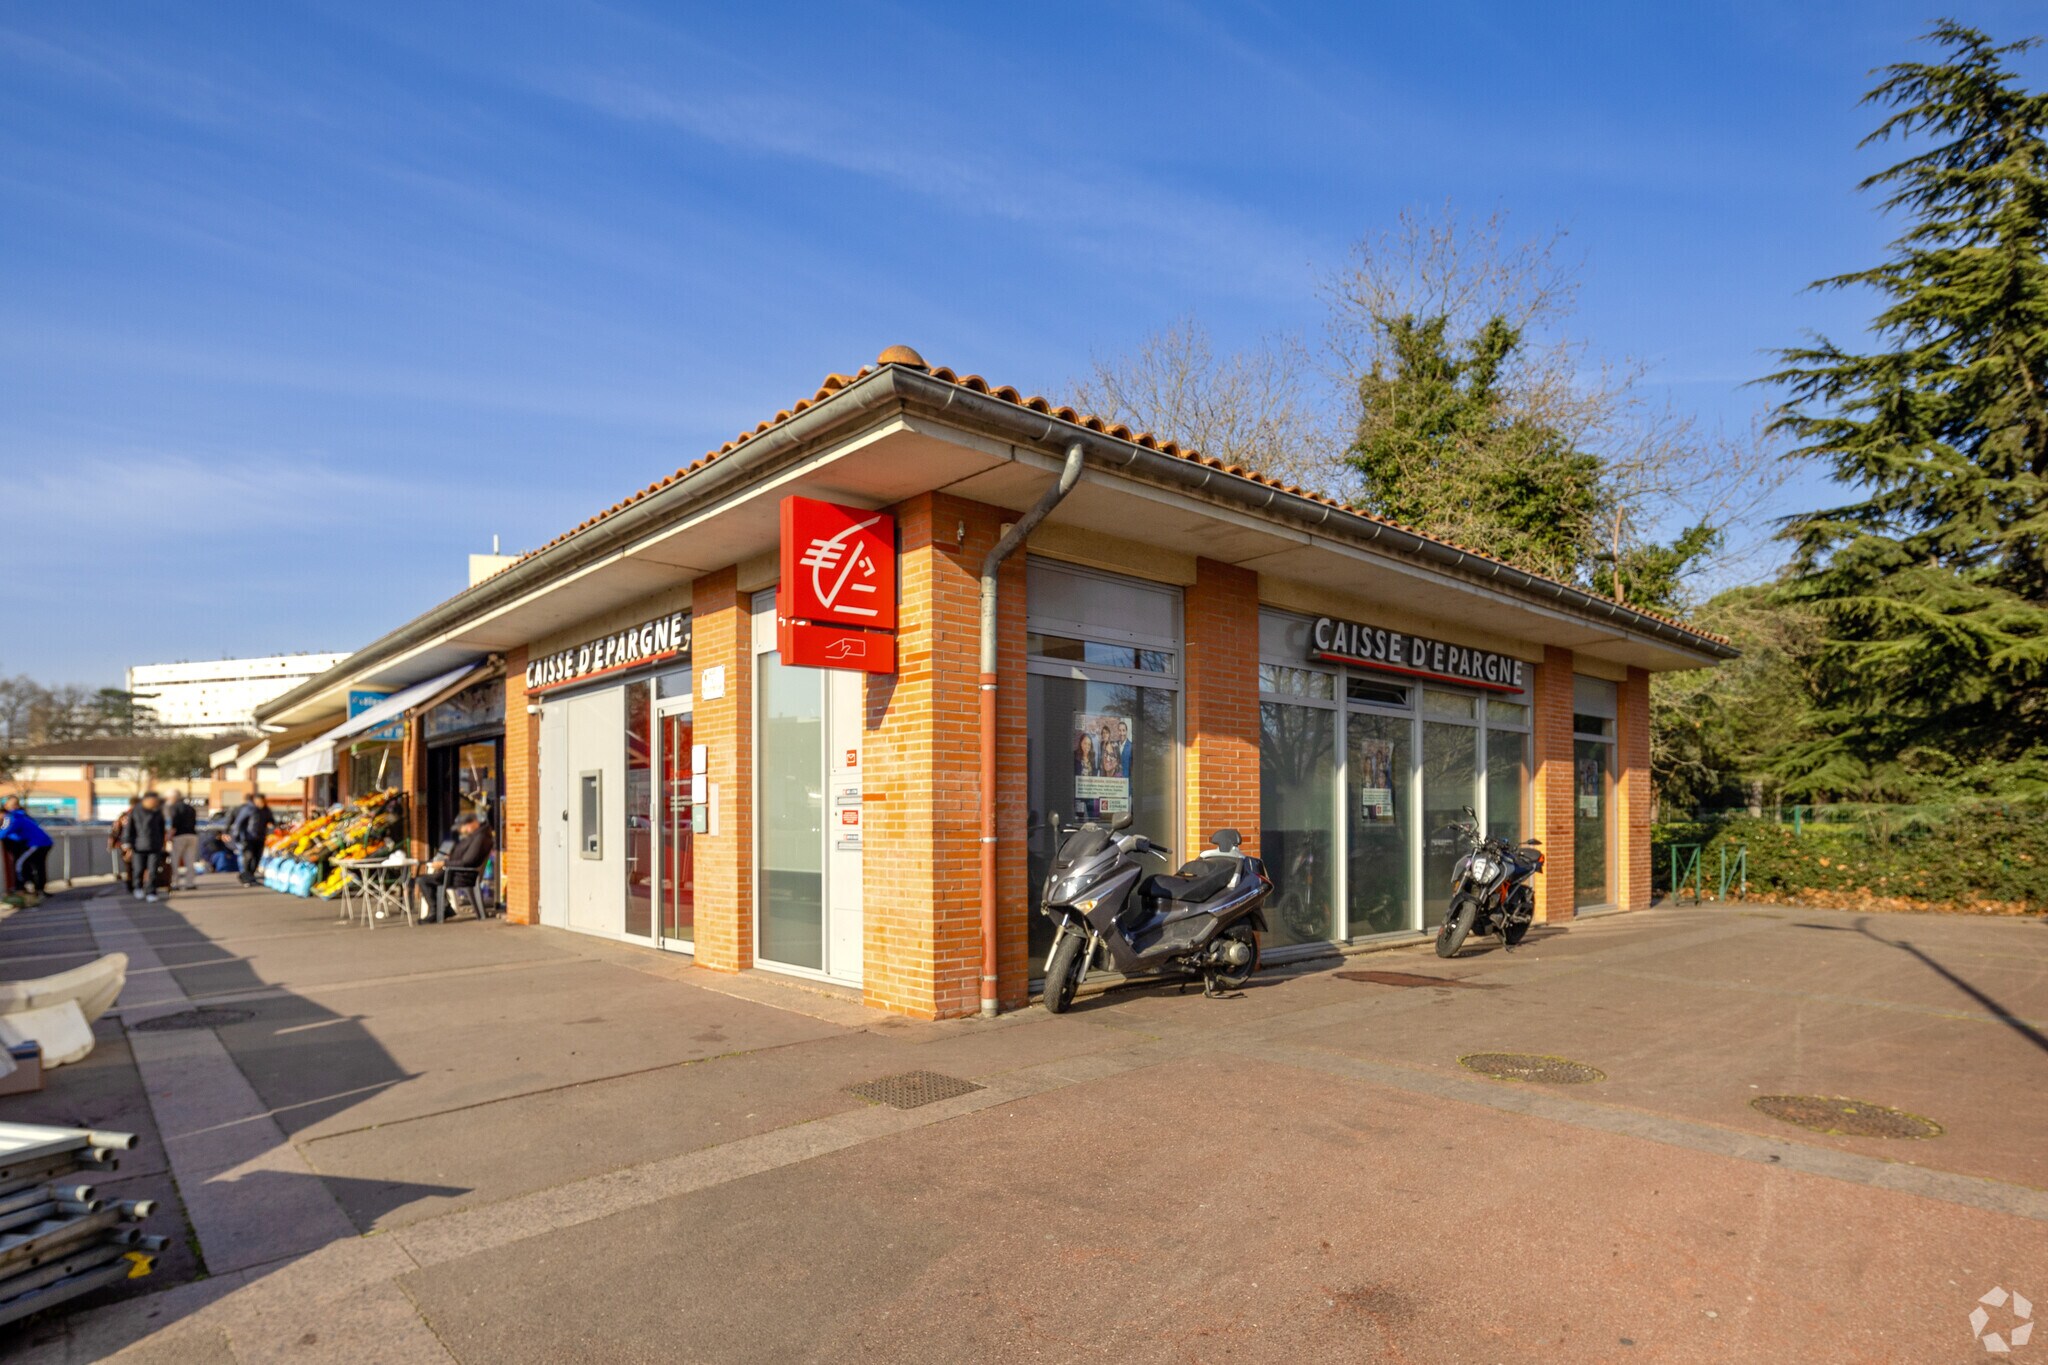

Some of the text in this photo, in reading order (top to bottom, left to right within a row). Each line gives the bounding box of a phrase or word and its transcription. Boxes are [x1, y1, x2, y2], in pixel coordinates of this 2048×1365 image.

[525, 614, 682, 689] CAISSE D'EPARGNE
[1314, 617, 1523, 686] CAISSE D'EPARGNE
